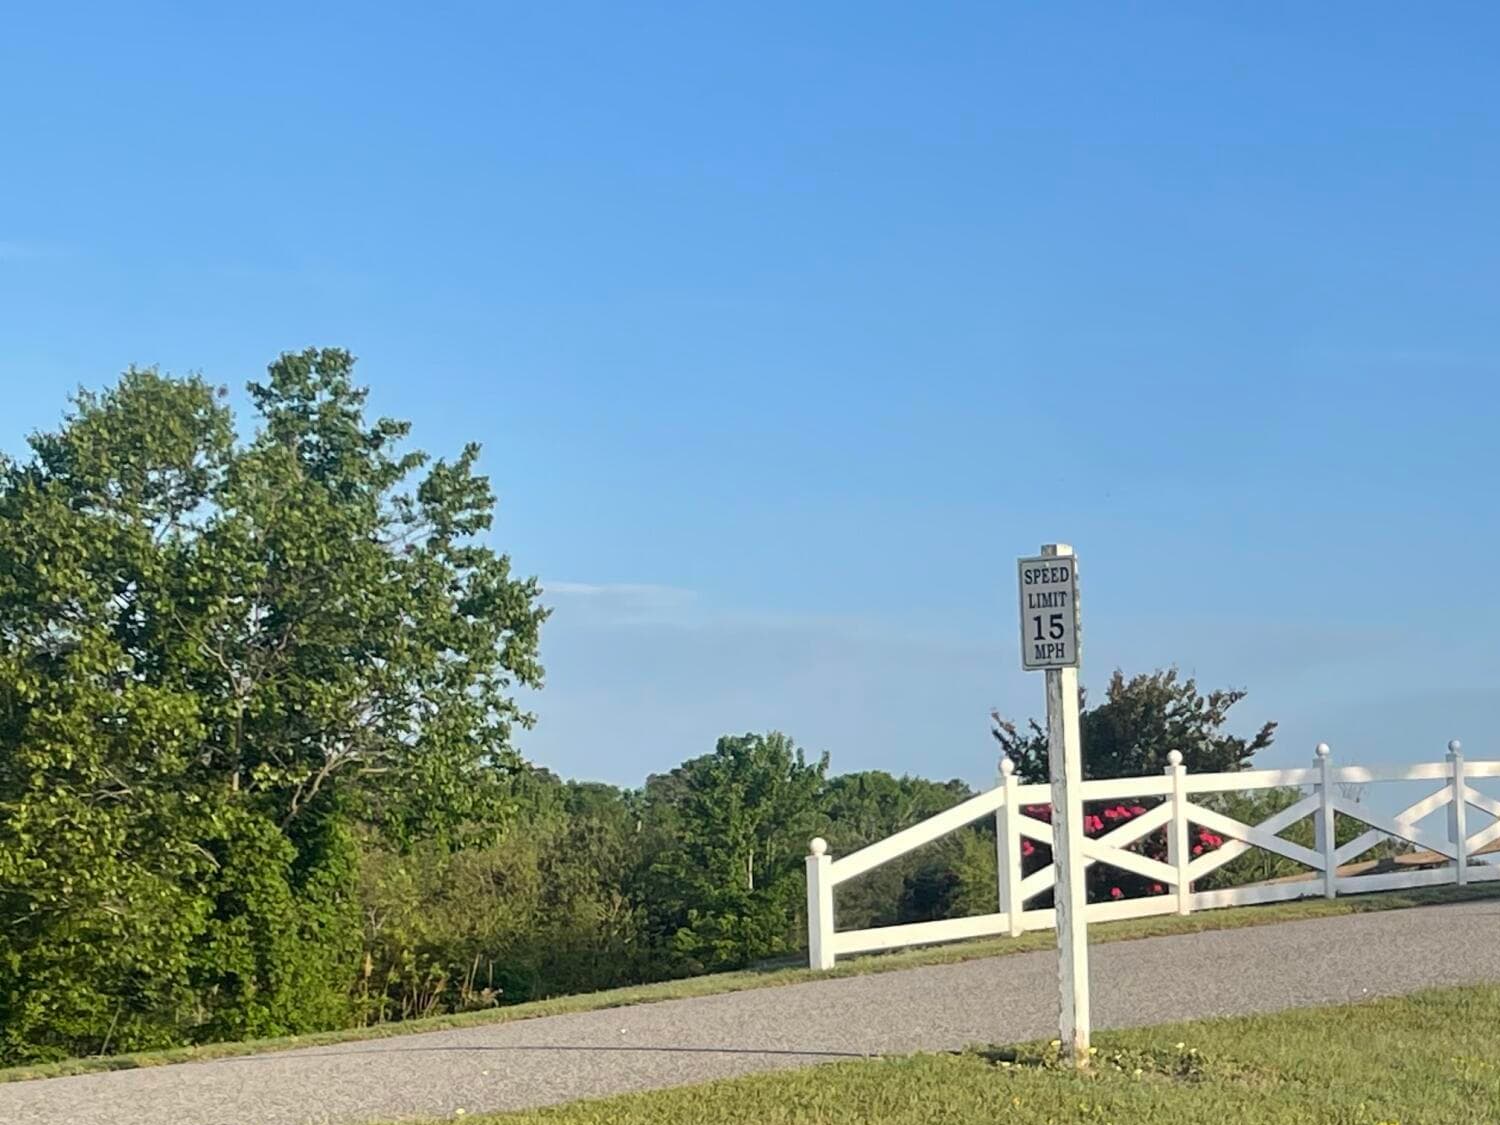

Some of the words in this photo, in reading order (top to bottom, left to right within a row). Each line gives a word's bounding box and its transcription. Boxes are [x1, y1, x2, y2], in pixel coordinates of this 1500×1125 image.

[1024, 567, 1069, 585] SPEED
[1028, 591, 1067, 609] LIMIT
[1033, 613, 1065, 640] 15
[1035, 643, 1065, 660] MPH
